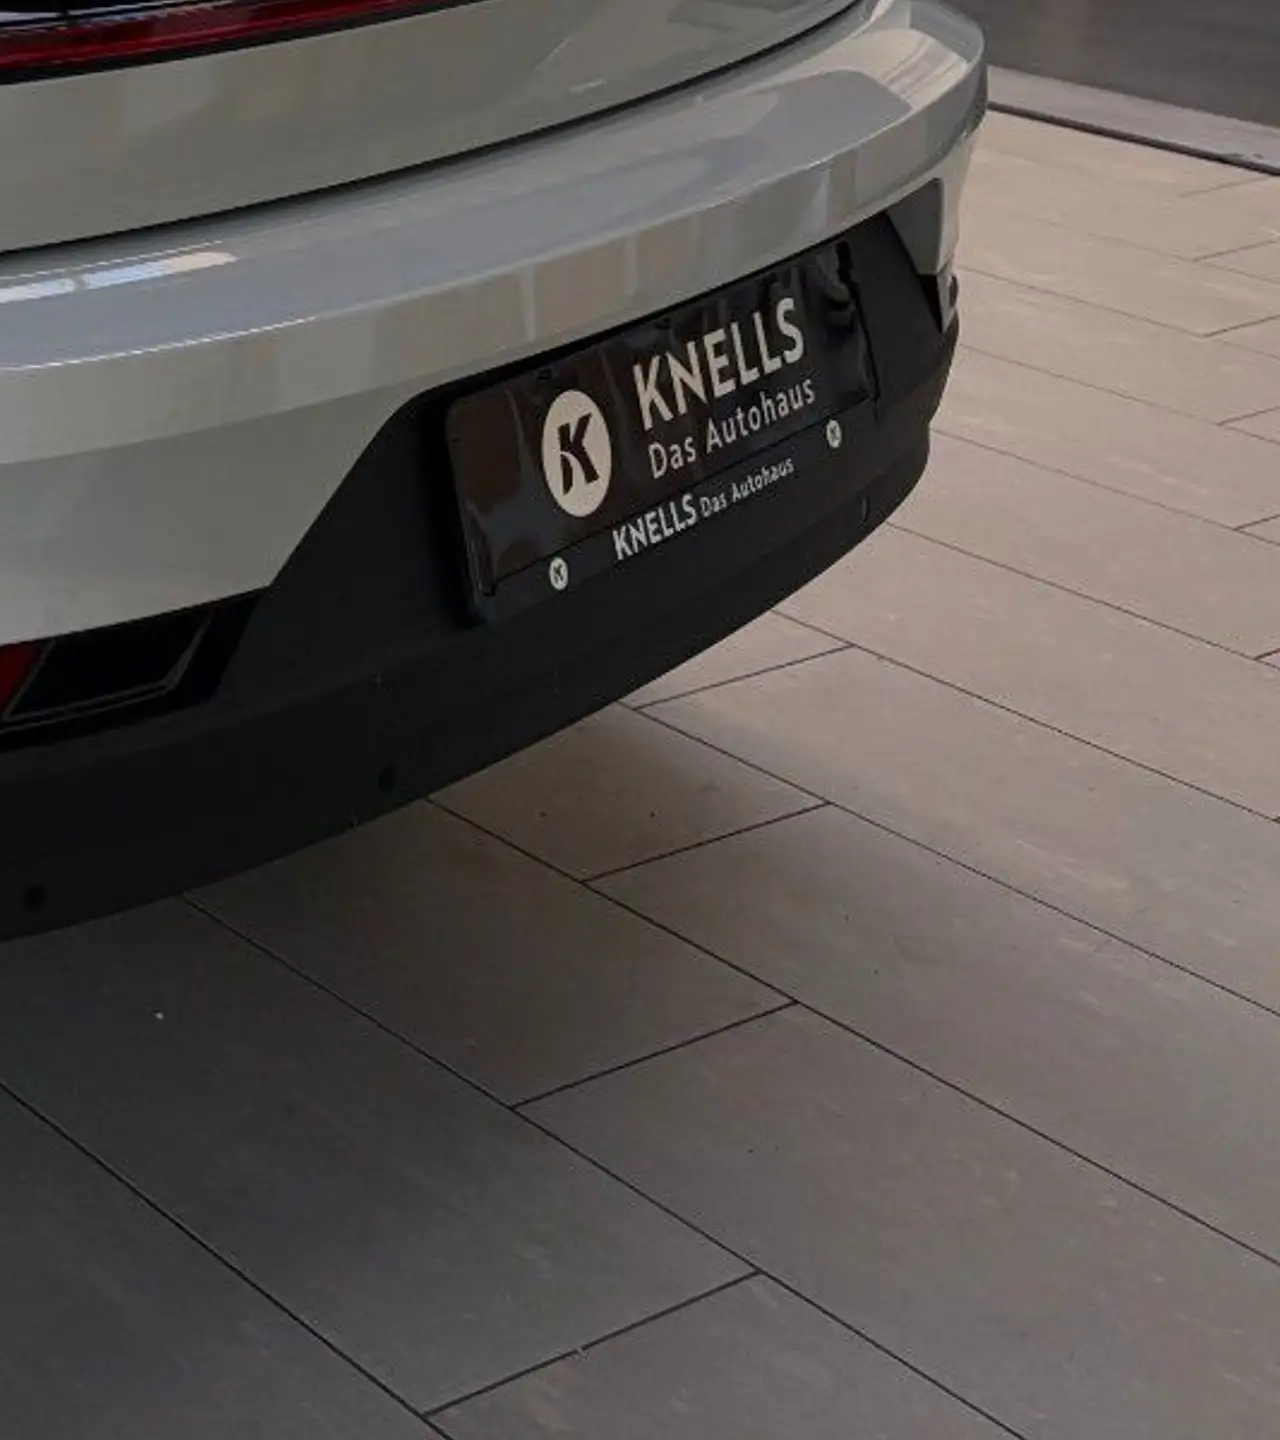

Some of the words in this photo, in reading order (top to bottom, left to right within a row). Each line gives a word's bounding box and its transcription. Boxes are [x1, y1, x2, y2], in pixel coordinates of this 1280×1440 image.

[633, 297, 804, 432] KNELLS
[648, 436, 697, 479] Das
[706, 379, 815, 454] Autohaus
[612, 493, 697, 561] KNELLS
[699, 493, 727, 518] Das
[732, 458, 795, 503] Autohaus
